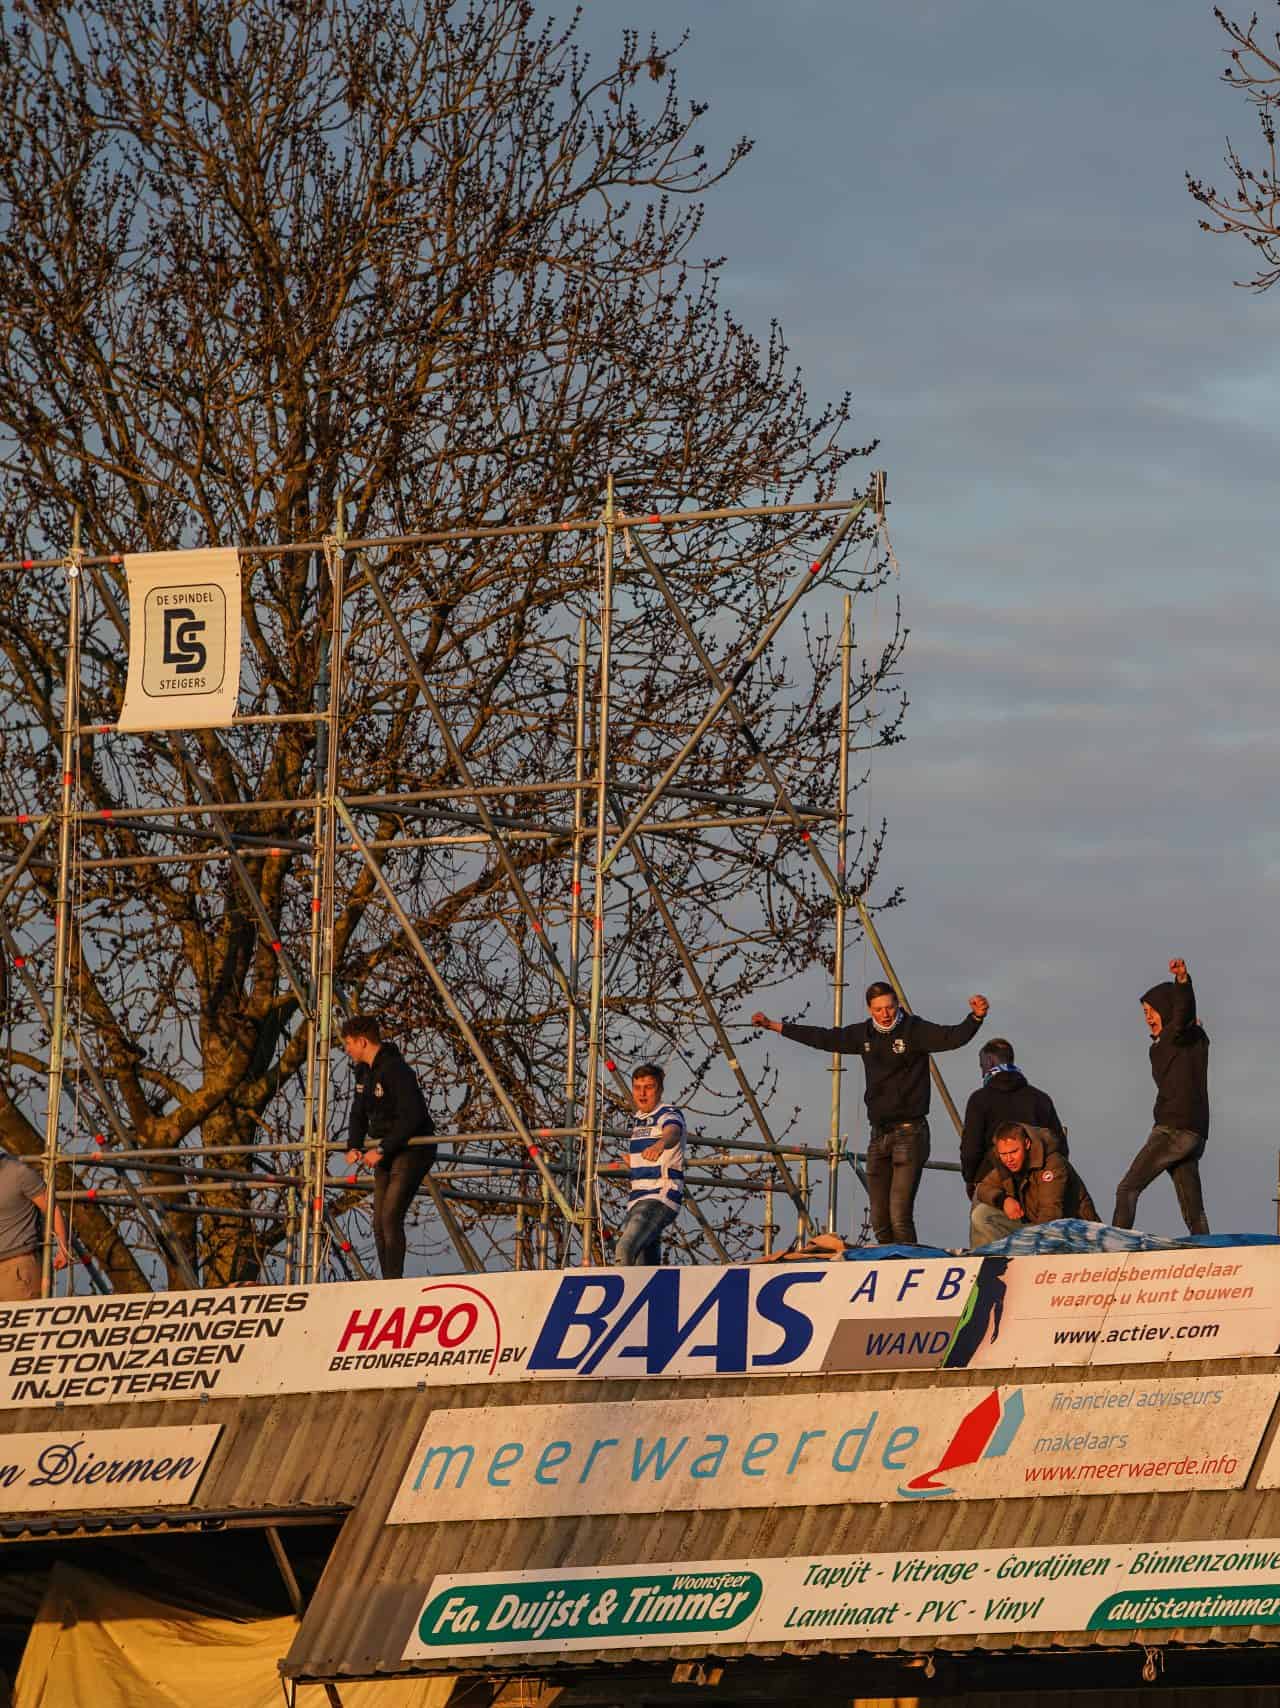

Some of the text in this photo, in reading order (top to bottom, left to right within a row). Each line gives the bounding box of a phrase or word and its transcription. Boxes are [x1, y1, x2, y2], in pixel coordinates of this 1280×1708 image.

[156, 591, 215, 606] DE SPINDEL
[159, 676, 207, 690] STEIGERS
[1034, 1262, 1243, 1286] de arbeidsbemiddelaar
[0, 1292, 310, 1329] BETONREPARATIES
[1049, 1284, 1254, 1310] waarop u kunt bouwen
[0, 1318, 285, 1353] BETONBORINGEN
[337, 1302, 478, 1352] HAPO
[526, 1268, 828, 1375] BAAS
[1053, 1322, 1221, 1345] www.actiev.com
[328, 1346, 527, 1372] BETONREPARATIE BV
[865, 1331, 951, 1357] WAND
[9, 1344, 244, 1377] BETONZAGEN
[11, 1369, 220, 1401] INJECTEREN
[1050, 1388, 1224, 1410] financieel adviseurs
[412, 1410, 920, 1491] meerwaerde
[1033, 1431, 1129, 1453] makelaars
[28, 1440, 201, 1487] Diermen
[1024, 1455, 1239, 1483] www.meerwaerde.info
[672, 1573, 751, 1591] Woonsfeer
[802, 1563, 872, 1588] Tapijt
[891, 1558, 978, 1586] Vitrage
[995, 1552, 1109, 1581] Gordijnen
[431, 1585, 751, 1639] Fa. Duijst & Timmer
[783, 1601, 900, 1629] Laminaat
[917, 1600, 964, 1624] PVC
[983, 1596, 1046, 1622] Vinyl
